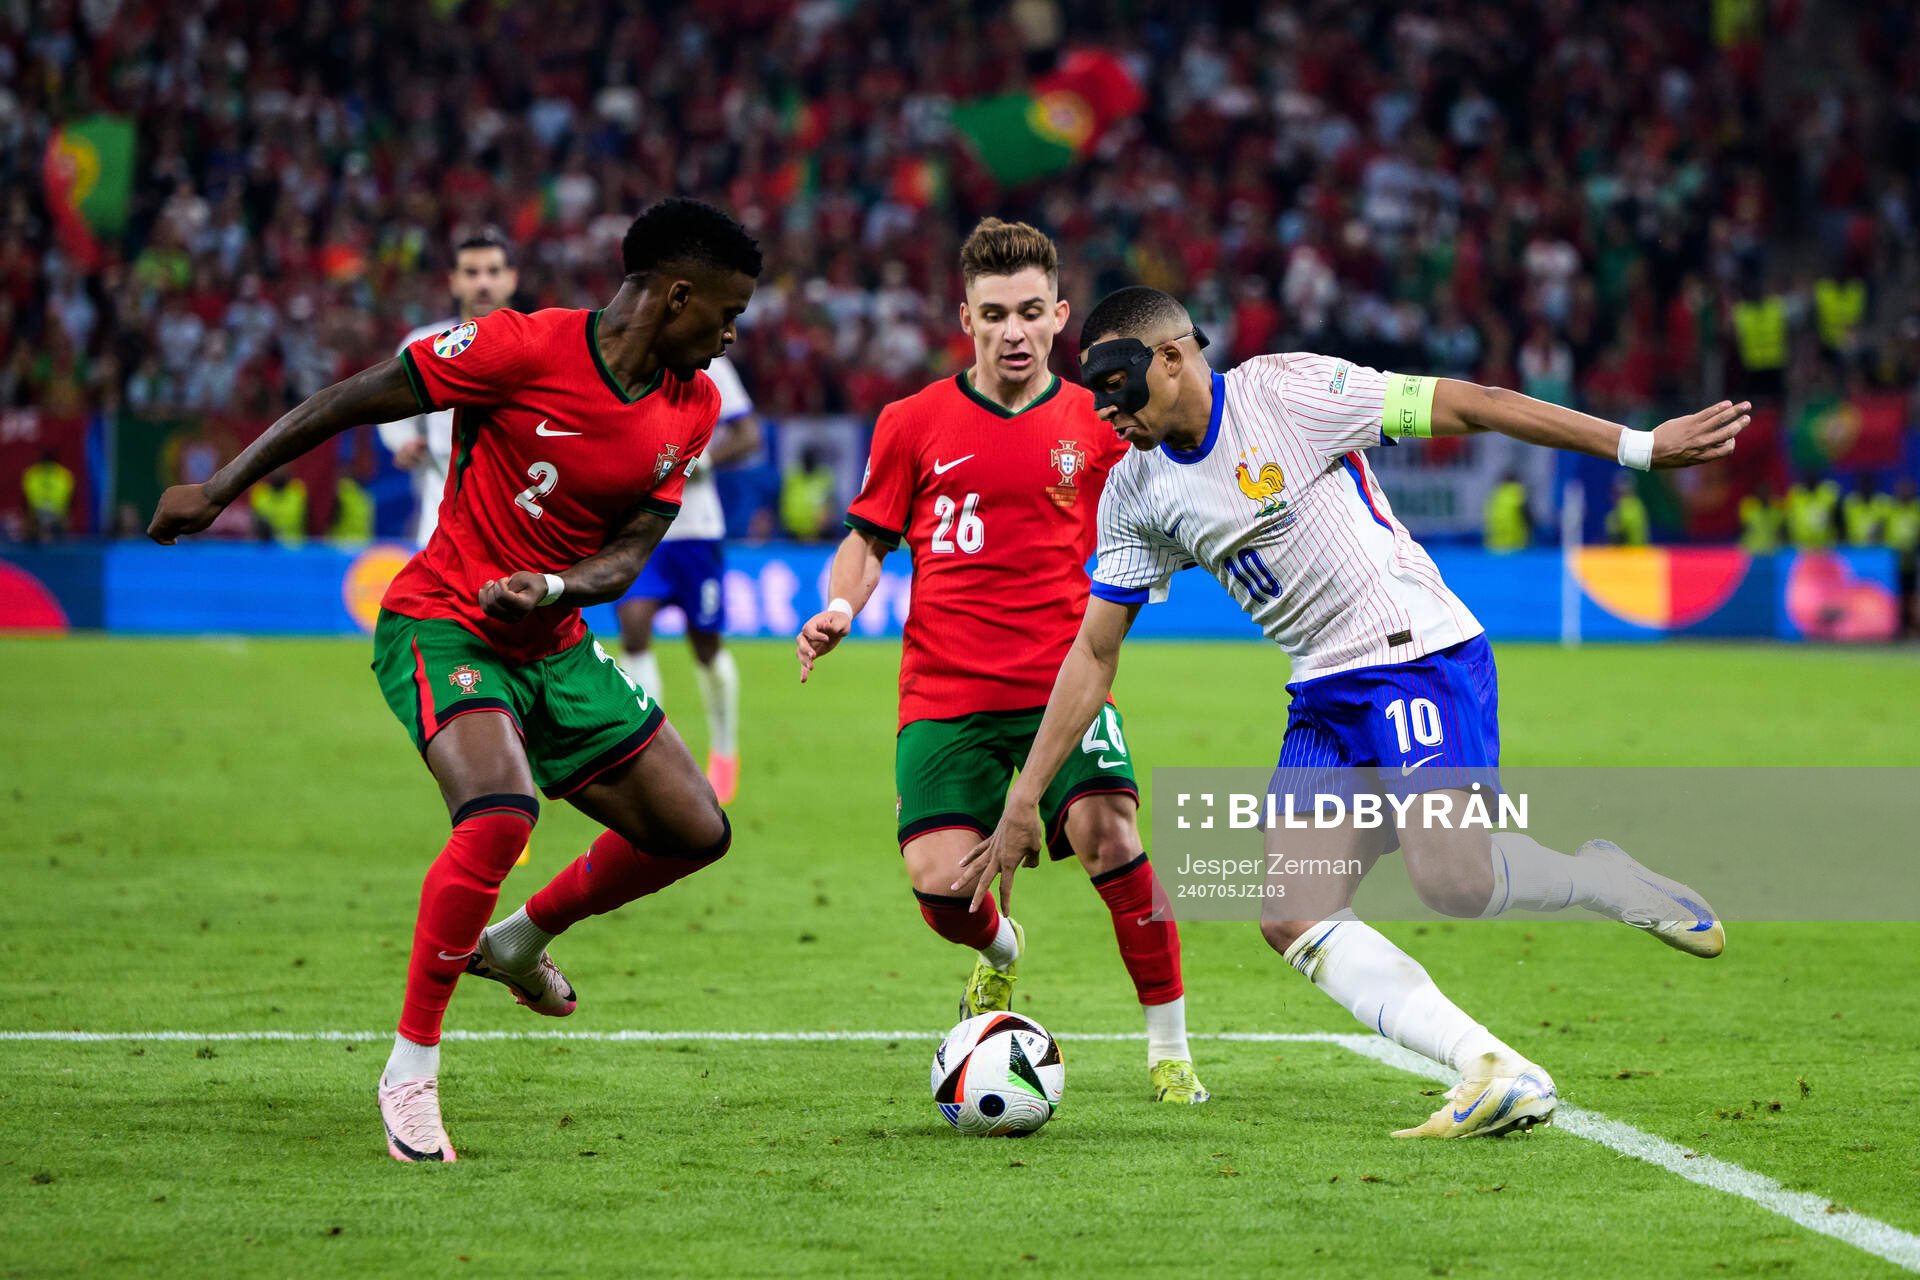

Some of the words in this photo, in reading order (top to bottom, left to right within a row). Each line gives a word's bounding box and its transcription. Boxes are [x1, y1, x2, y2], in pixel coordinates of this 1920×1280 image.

[514, 461, 559, 519] 2
[931, 493, 985, 554] 26
[1224, 548, 1283, 605] 10
[1385, 698, 1444, 754] 10
